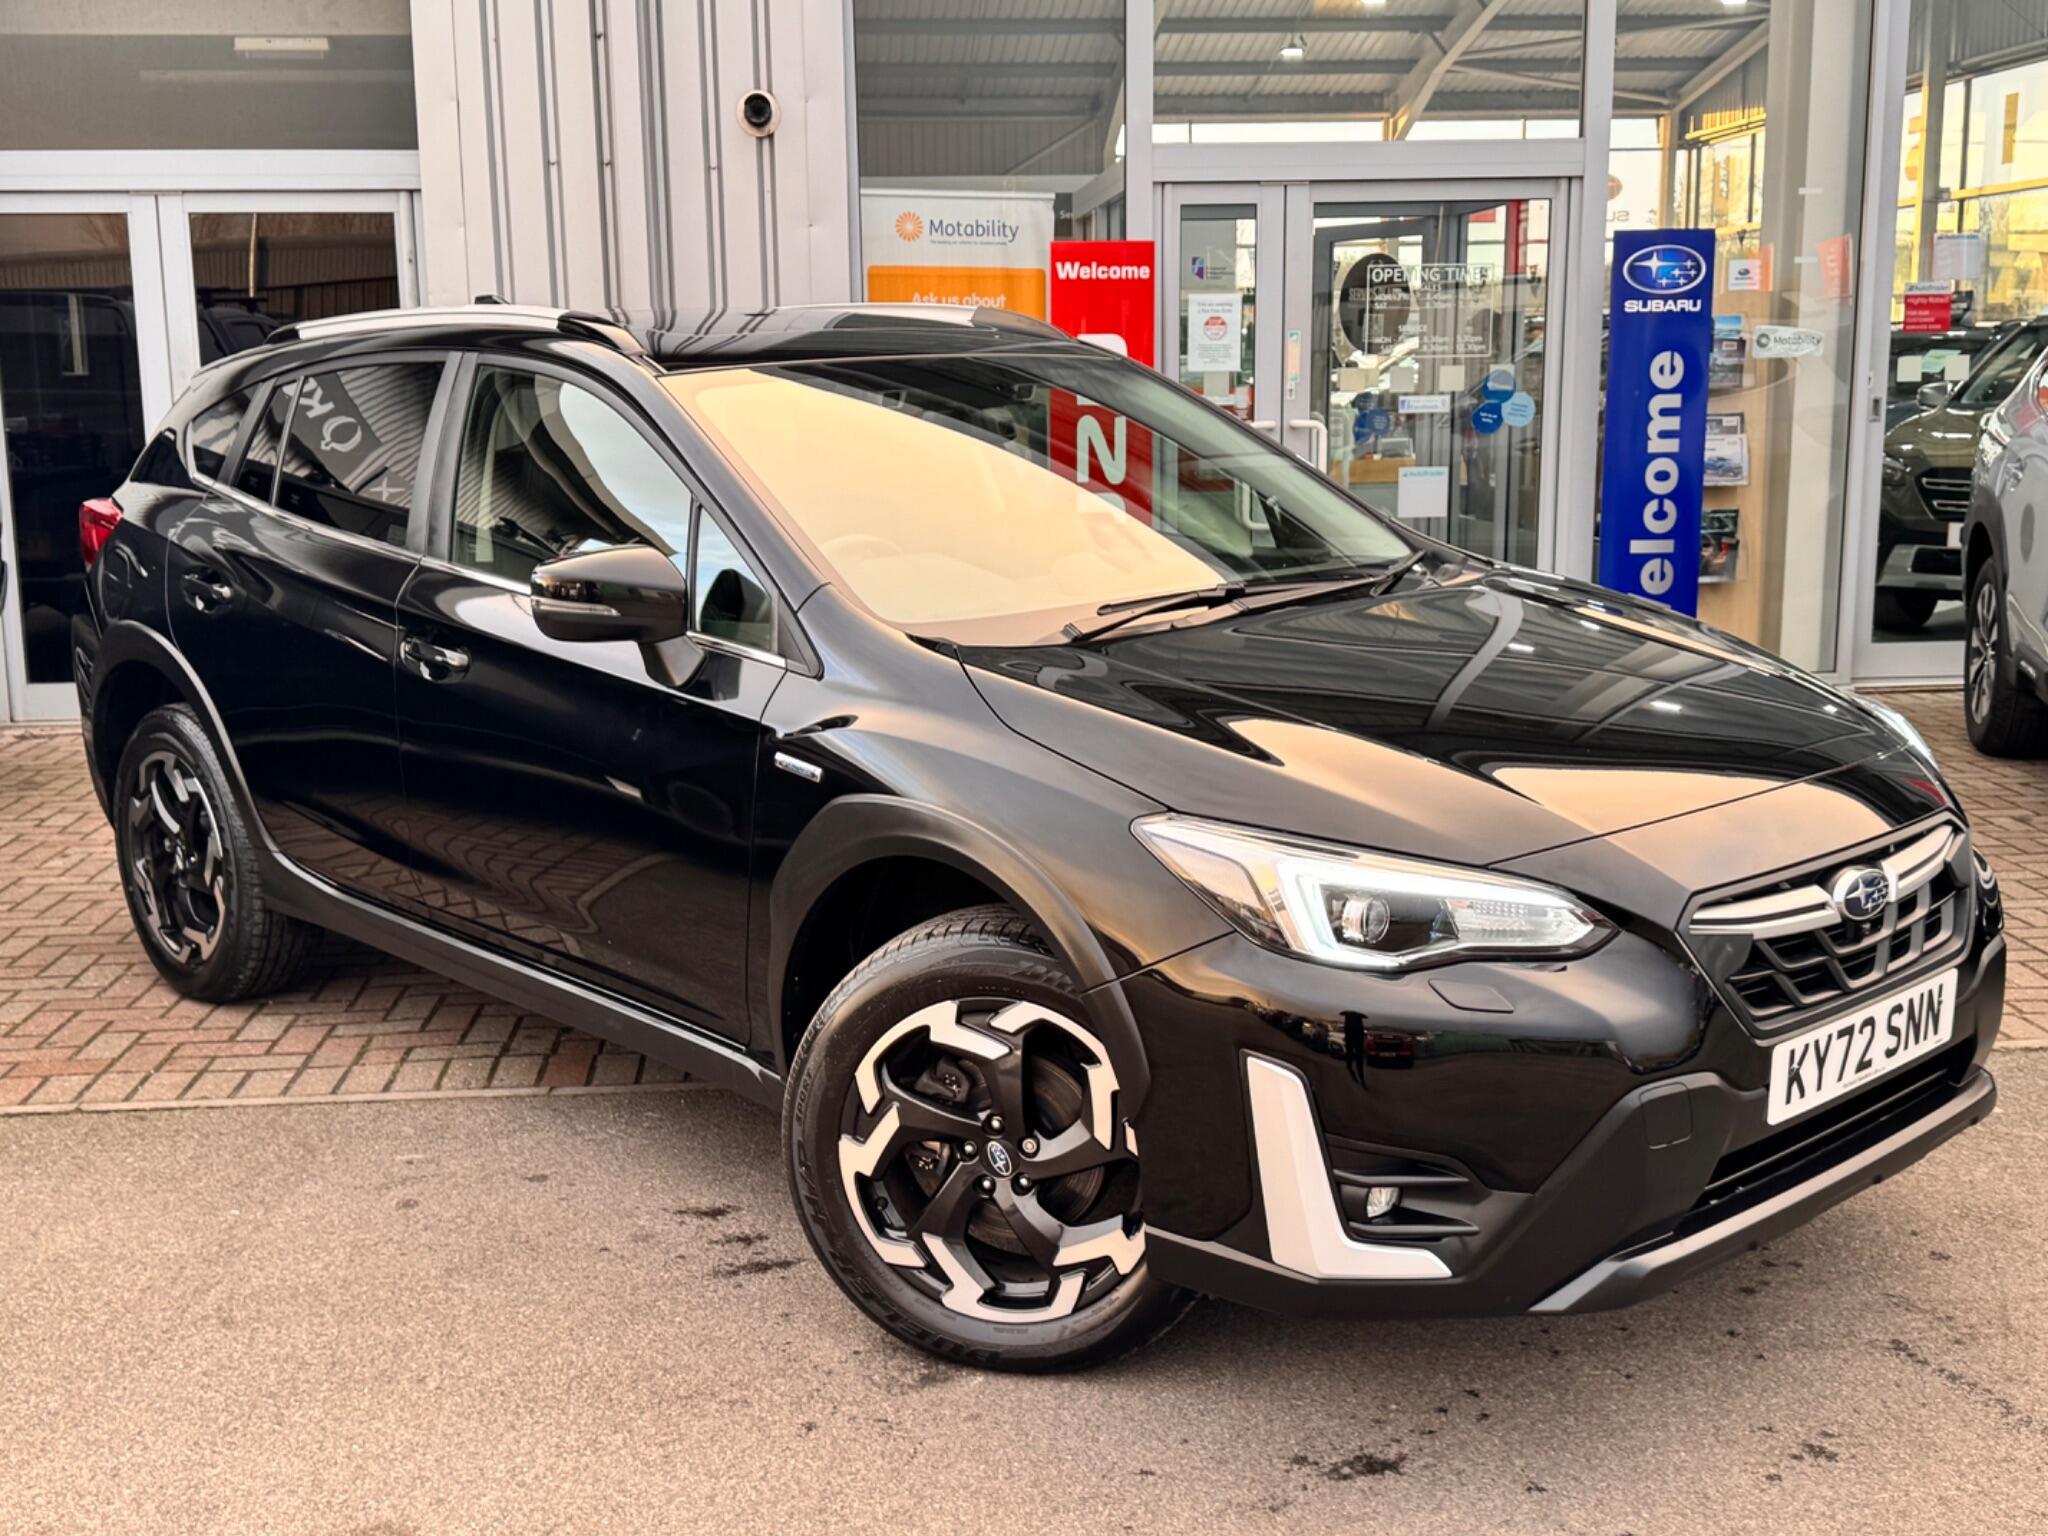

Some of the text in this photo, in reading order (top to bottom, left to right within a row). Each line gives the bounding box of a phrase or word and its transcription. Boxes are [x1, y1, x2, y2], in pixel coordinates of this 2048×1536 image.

[928, 219, 1019, 243] Motability
[1055, 261, 1151, 280] Welcome
[962, 292, 1007, 309] about
[1624, 299, 1702, 312] SUBARU
[1773, 335, 1823, 346] Motability
[1627, 351, 1685, 609] elcome
[1784, 983, 1942, 1106] KY72 SNN
